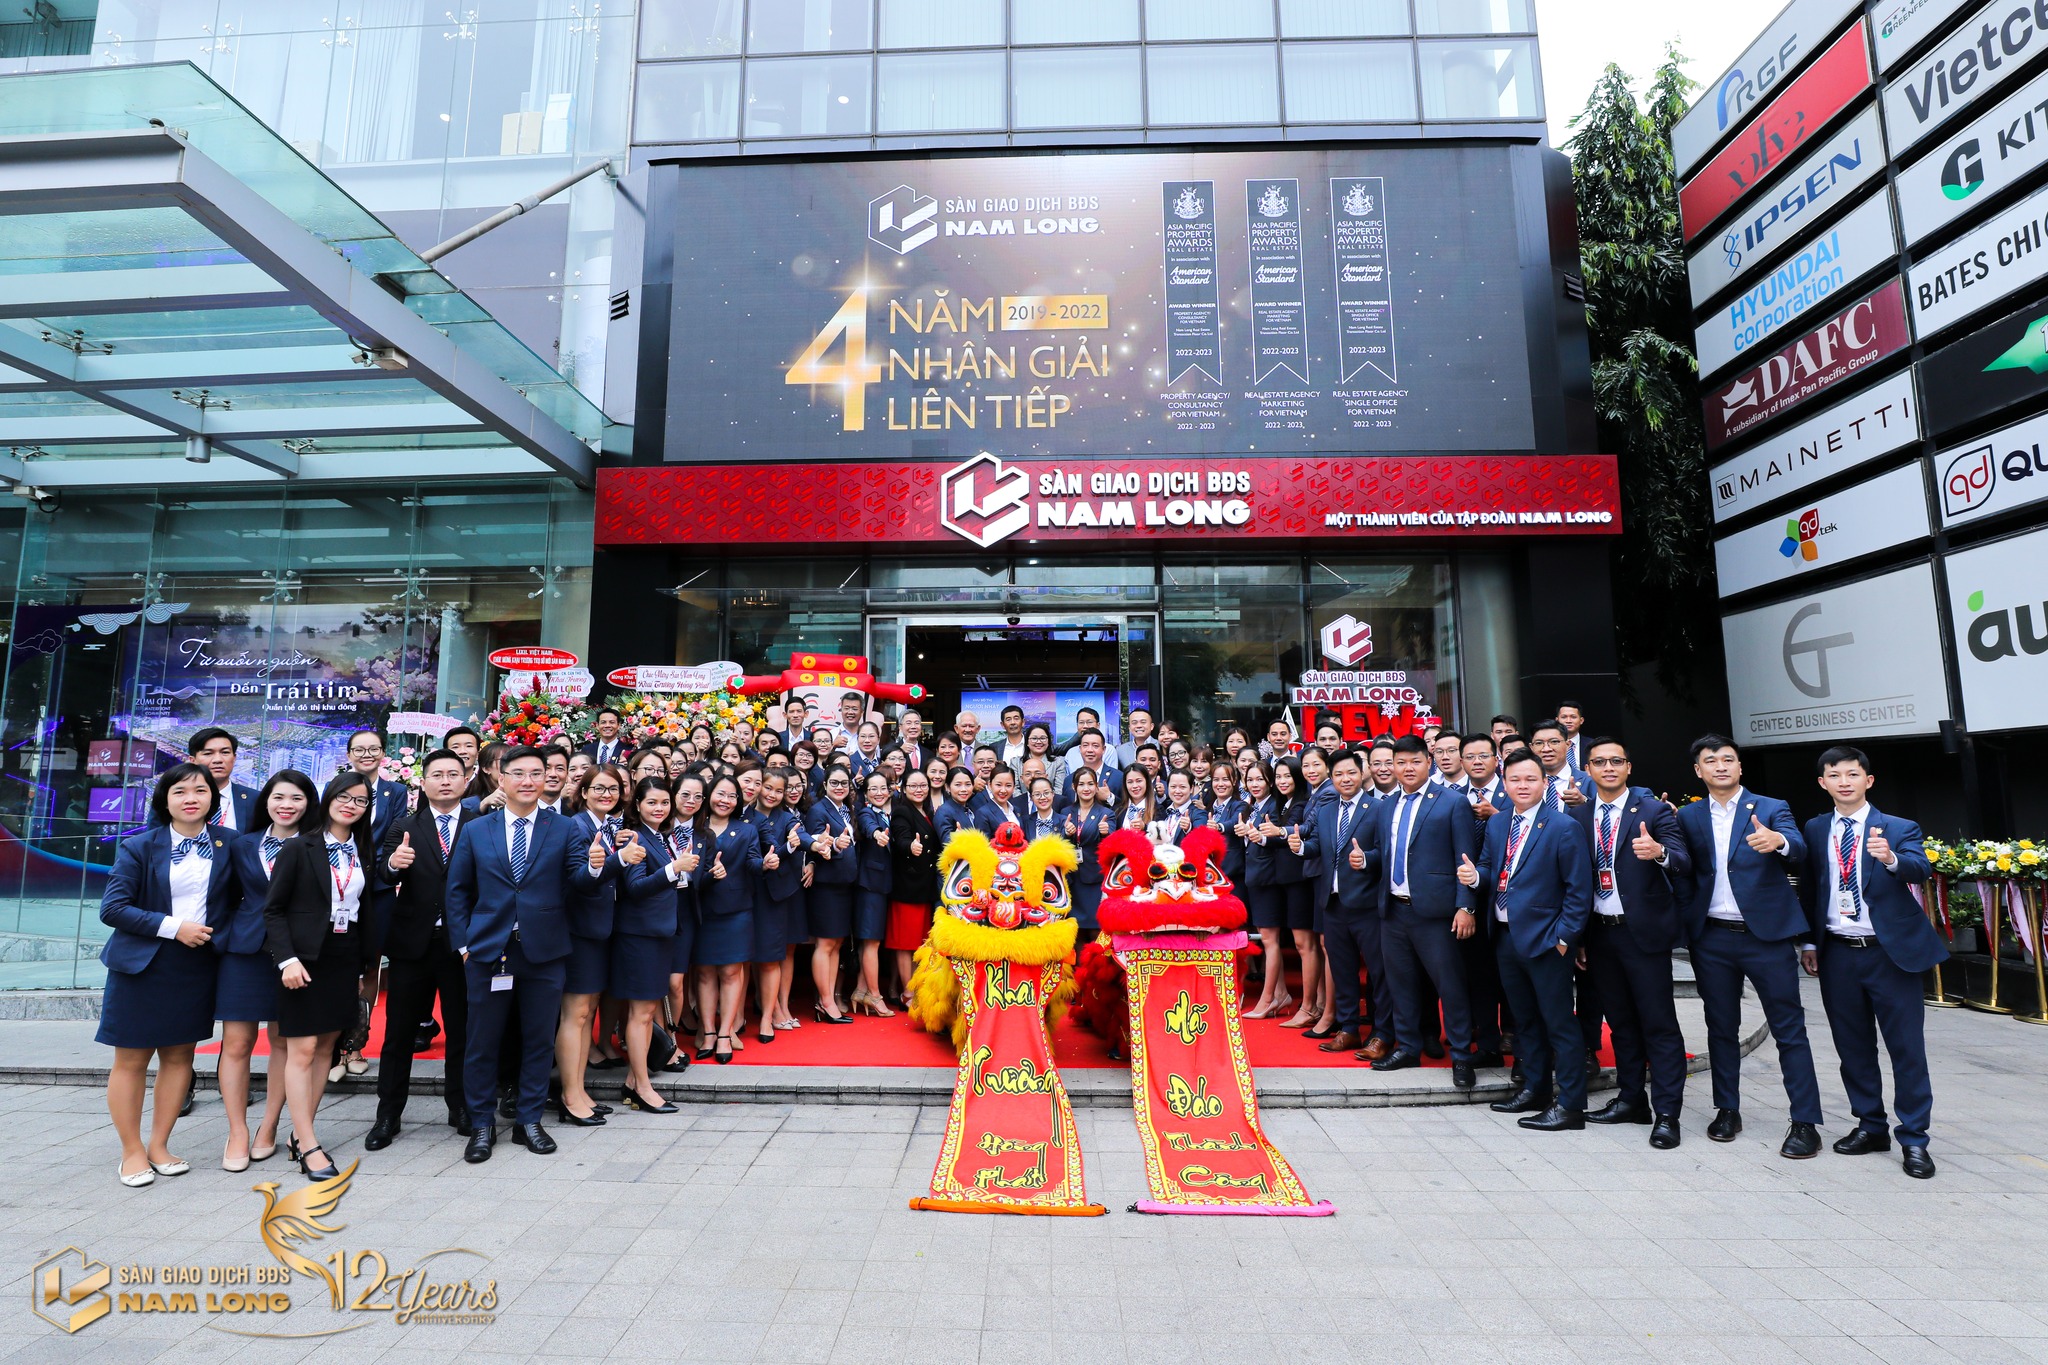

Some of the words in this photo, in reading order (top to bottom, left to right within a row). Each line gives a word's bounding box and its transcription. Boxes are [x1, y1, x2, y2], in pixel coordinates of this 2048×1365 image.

[1736, 33, 1797, 113] RGF
[1744, 138, 1862, 252] IPSEN
[945, 196, 976, 213] SÀN
[983, 198, 1019, 212] GIAO
[1025, 197, 1061, 213] DỊCH
[1068, 196, 1099, 210] BĐS
[945, 219, 1016, 236] NAM
[1023, 217, 1099, 234] LONG
[1252, 229, 1297, 237] PROPERTY
[1337, 227, 1382, 235] PROPERTY
[1167, 230, 1212, 238] PROPERTY
[1337, 235, 1383, 244] AWARDS
[1167, 238, 1213, 247] AWARDS
[1252, 237, 1298, 246] AWARDS
[1341, 263, 1384, 273] American
[1918, 251, 1989, 311] BATES
[1996, 211, 2048, 267] CHI
[1170, 266, 1213, 275] American
[1255, 264, 1298, 274] American
[1169, 275, 1210, 285] Standard
[1255, 273, 1296, 284] Standard
[1341, 272, 1382, 282] Standard
[1730, 231, 1841, 329] HYUNDAI
[889, 289, 994, 334] NĂM
[1734, 266, 1844, 351] corporation
[1175, 348, 1213, 356] 2022-2023
[1262, 347, 1299, 355] 2022-2023
[1349, 346, 1386, 354] 2022-2023
[1759, 298, 1876, 402] DAFC
[785, 286, 881, 431] 4
[889, 340, 1016, 388] NHẬN
[1029, 336, 1109, 379] GIẢI
[1160, 392, 1196, 400] PROPERTY
[1244, 391, 1262, 399] REAL
[1289, 390, 1321, 398] AGENCY
[1332, 390, 1350, 398] REAL
[1726, 429, 1732, 437] A
[1733, 409, 1769, 433] subsidiary
[1770, 401, 1778, 412] of
[1780, 392, 1800, 410] Imex
[1801, 383, 1817, 397] Pan
[1818, 367, 1847, 387] Pacific
[1848, 350, 1878, 371] Group
[888, 387, 976, 430] LIÊN
[985, 385, 1071, 428] TIẾP
[1168, 401, 1223, 409] CONSULTANCY
[1345, 399, 1371, 407] SINGLE
[1740, 398, 1910, 492] MAINETTI
[1039, 469, 1082, 495] SÀN
[1091, 473, 1140, 494] GIAO
[1148, 472, 1198, 497] DỊCH
[1207, 471, 1250, 492] BĐS
[1038, 501, 1136, 526] NAM
[1145, 500, 1251, 525] LONG
[1325, 512, 1351, 528] MỘT
[1355, 511, 1397, 525] THÀNH
[1399, 511, 1428, 525] VIÊN
[1430, 510, 1454, 525] CỦA
[1456, 511, 1478, 527] TẬP
[1480, 510, 1516, 525] ĐOÀN
[1519, 511, 1562, 524] NAM
[1566, 511, 1612, 523] LONG
[1306, 670, 1326, 682] SÀN
[1330, 671, 1354, 682] GIAO
[1358, 672, 1381, 684] DỊCH
[1385, 671, 1406, 682] BĐS
[231, 681, 259, 694] Đến
[261, 680, 309, 700] Trái
[317, 680, 358, 699] tim
[1297, 688, 1351, 702] NAM
[1358, 688, 1416, 701] LONG
[1750, 717, 1793, 734] CENTEC
[1795, 710, 1856, 729] BUSINESS
[1860, 703, 1917, 723] CENTER
